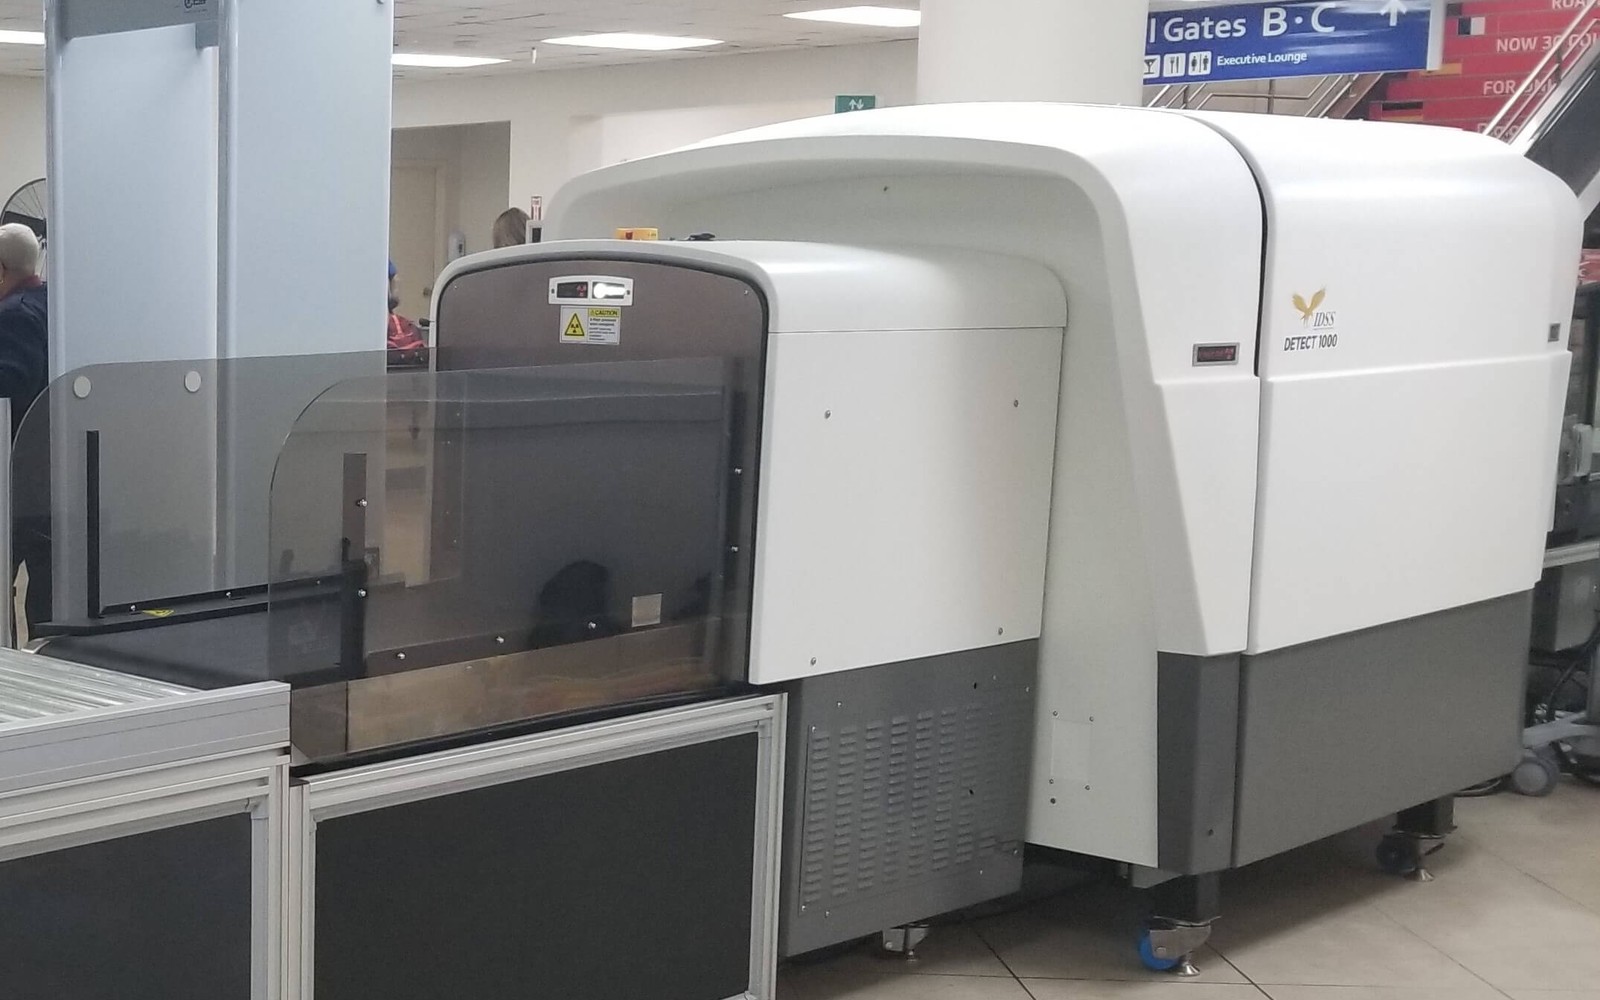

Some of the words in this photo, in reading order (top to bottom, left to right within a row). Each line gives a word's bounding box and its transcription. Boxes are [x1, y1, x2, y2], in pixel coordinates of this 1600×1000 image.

[1552, 0, 1599, 9] ROA
[1163, 17, 1247, 42] Gates
[1497, 37, 1537, 52] NOW
[1217, 53, 1267, 66] Executive
[1268, 51, 1307, 64] Lounge
[1483, 80, 1516, 95] FOR
[1313, 311, 1336, 327] IDSS
[1284, 336, 1317, 351] DETECT
[1318, 334, 1338, 349] 1000
